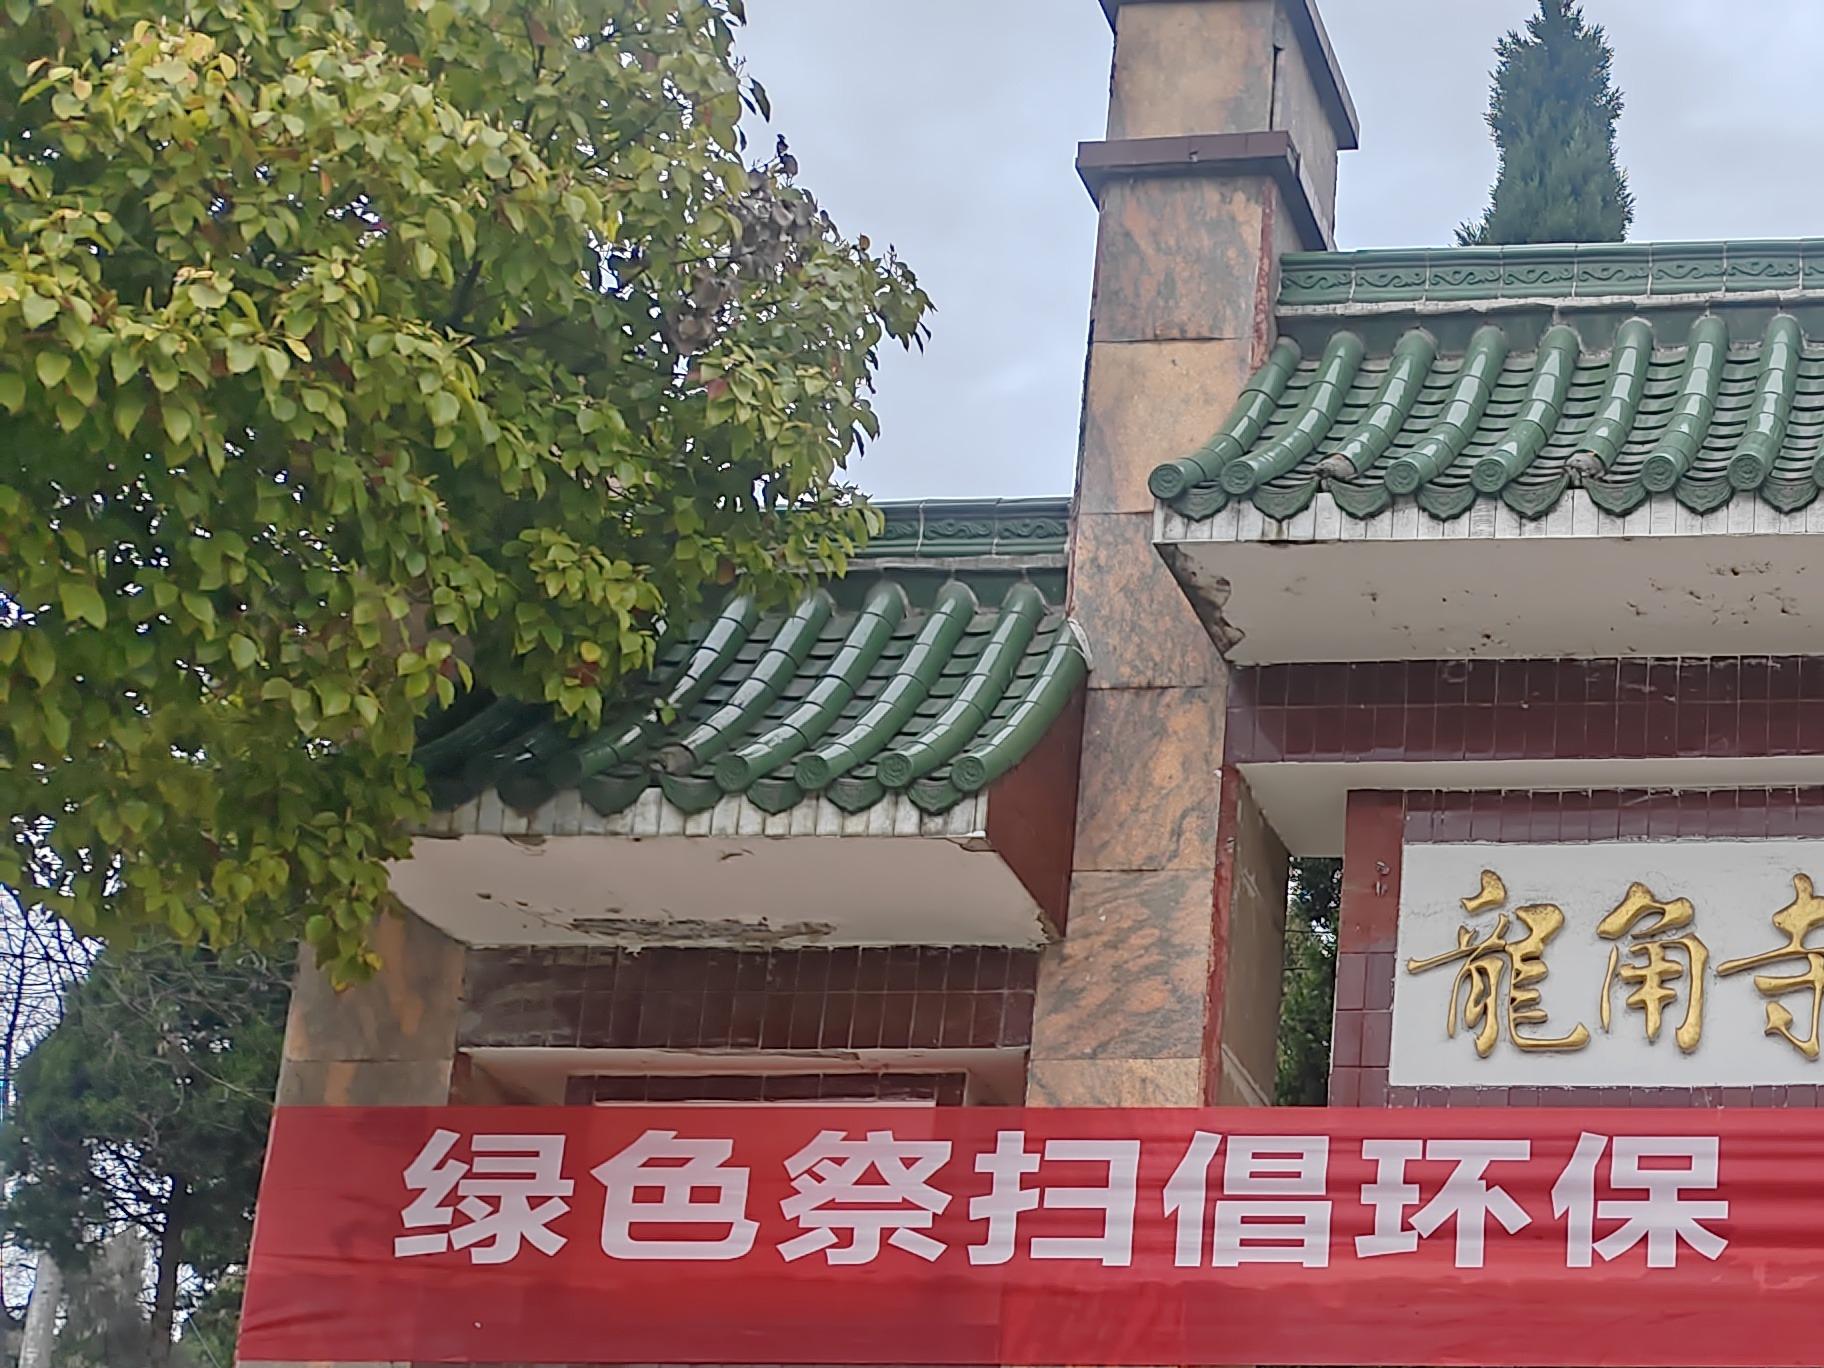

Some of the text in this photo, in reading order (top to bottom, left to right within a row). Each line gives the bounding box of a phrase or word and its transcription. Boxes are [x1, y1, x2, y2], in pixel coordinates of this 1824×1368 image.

[393, 1127, 1729, 1269] 绿色祭扫倡环保
